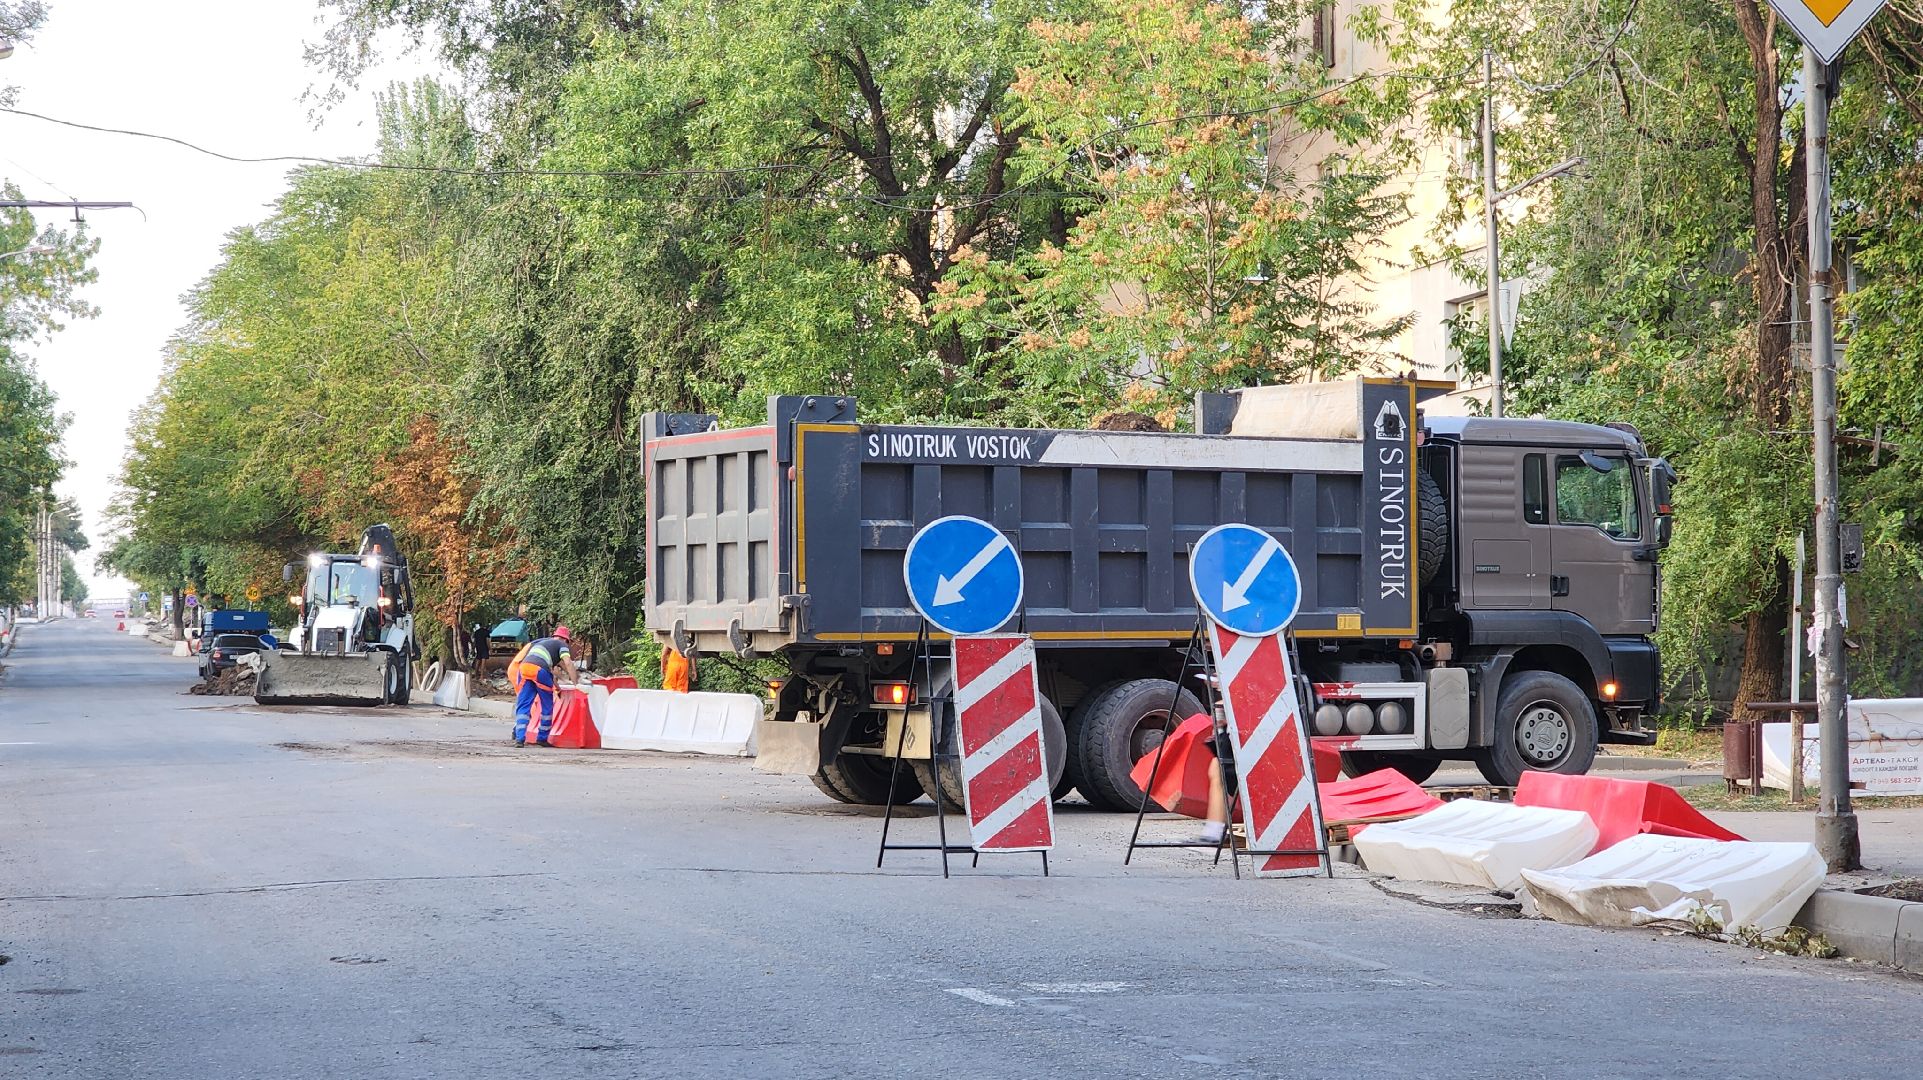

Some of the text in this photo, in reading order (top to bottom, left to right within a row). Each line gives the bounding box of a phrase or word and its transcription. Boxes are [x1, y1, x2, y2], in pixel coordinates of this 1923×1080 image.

[868, 433, 1031, 459] SINOTRUK VOSTOK
[1379, 447, 1405, 600] SINOTRUK
[248, 589, 257, 597] 40
